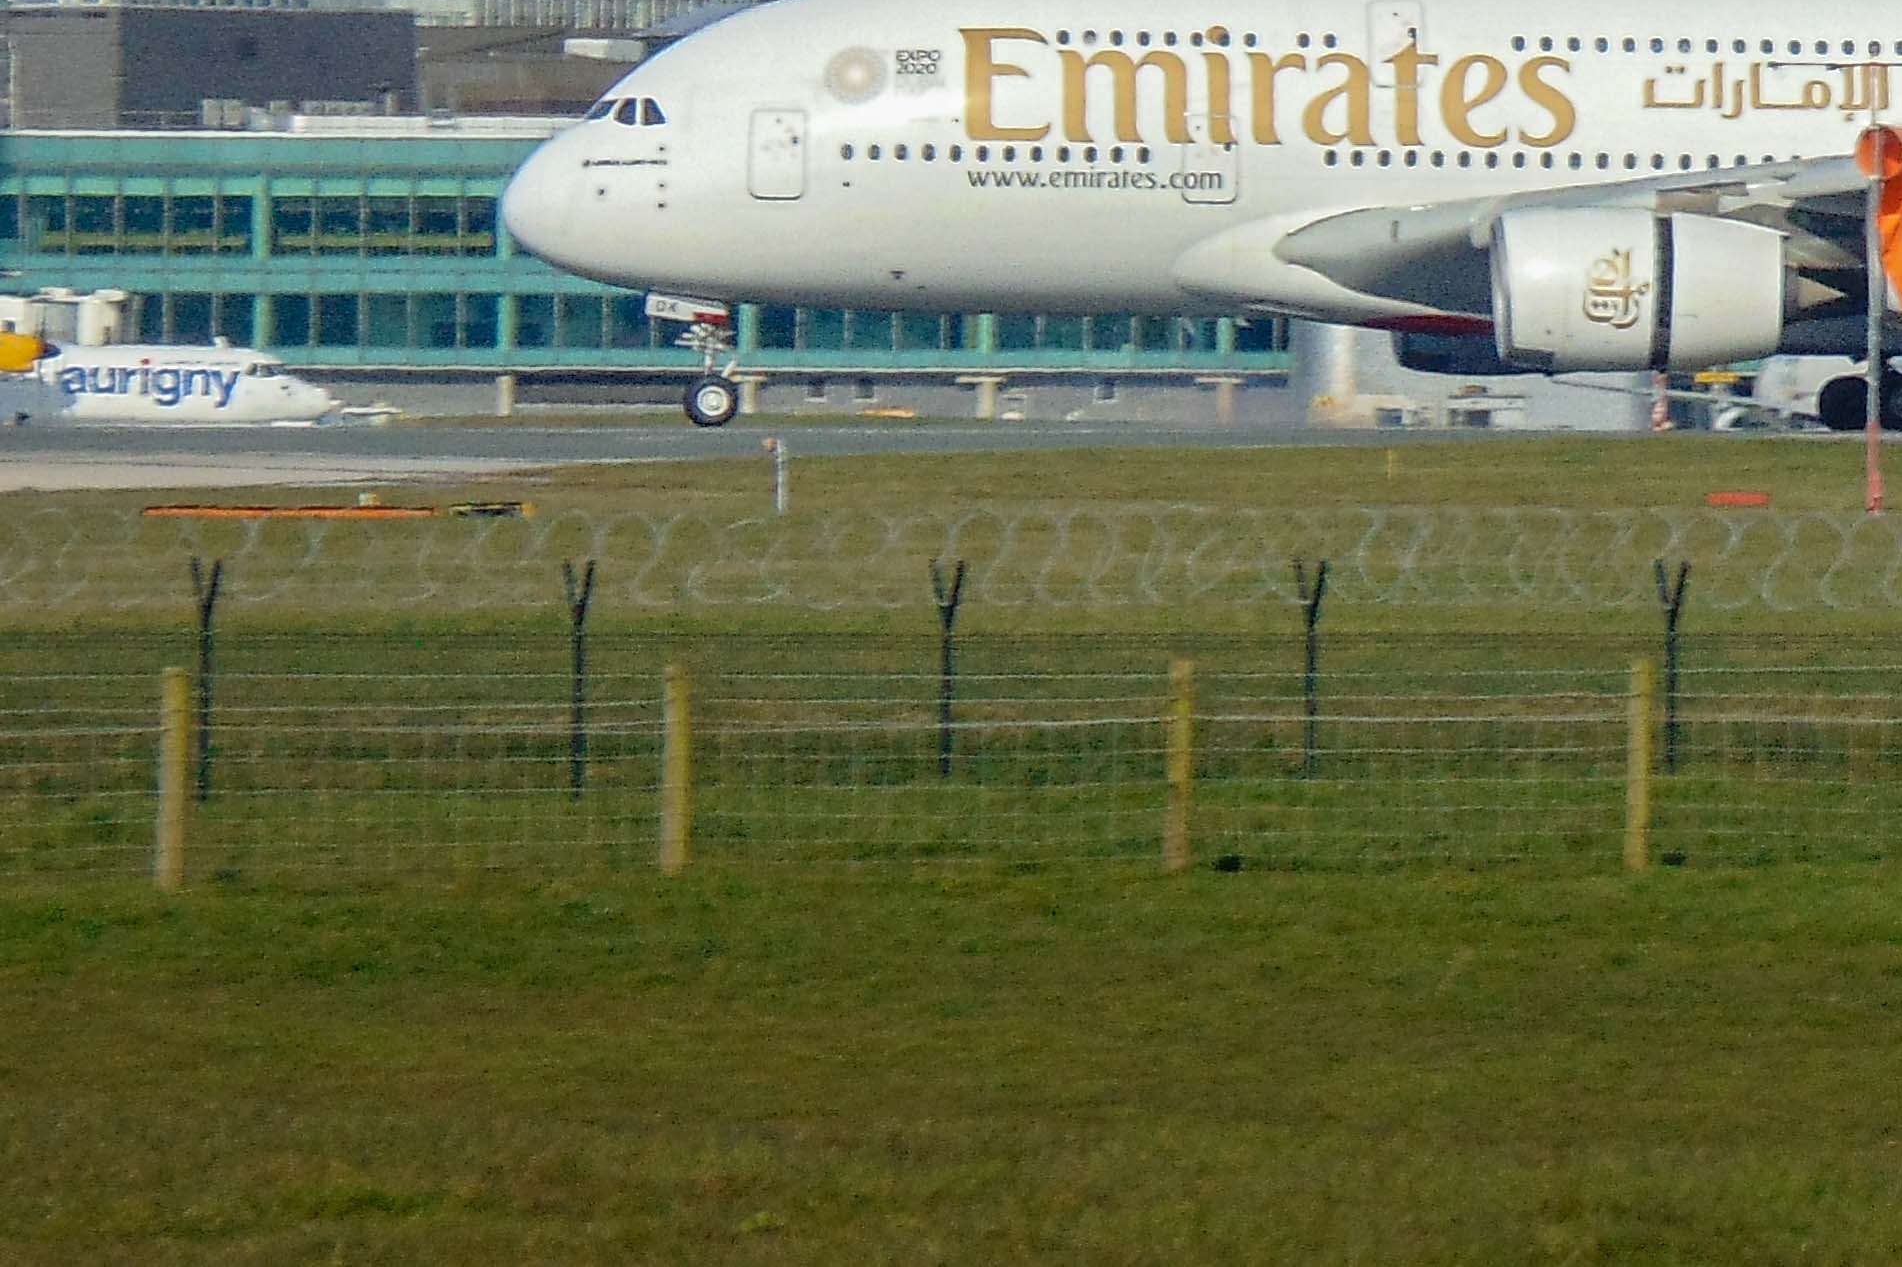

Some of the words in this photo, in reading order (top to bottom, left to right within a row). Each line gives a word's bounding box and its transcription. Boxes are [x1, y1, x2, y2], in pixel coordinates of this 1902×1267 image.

[896, 49, 941, 62] EXPO
[896, 62, 937, 75] 2020
[958, 26, 1577, 149] Emirates
[967, 166, 1223, 189] www.emirates.com
[60, 358, 241, 408] aurigny
